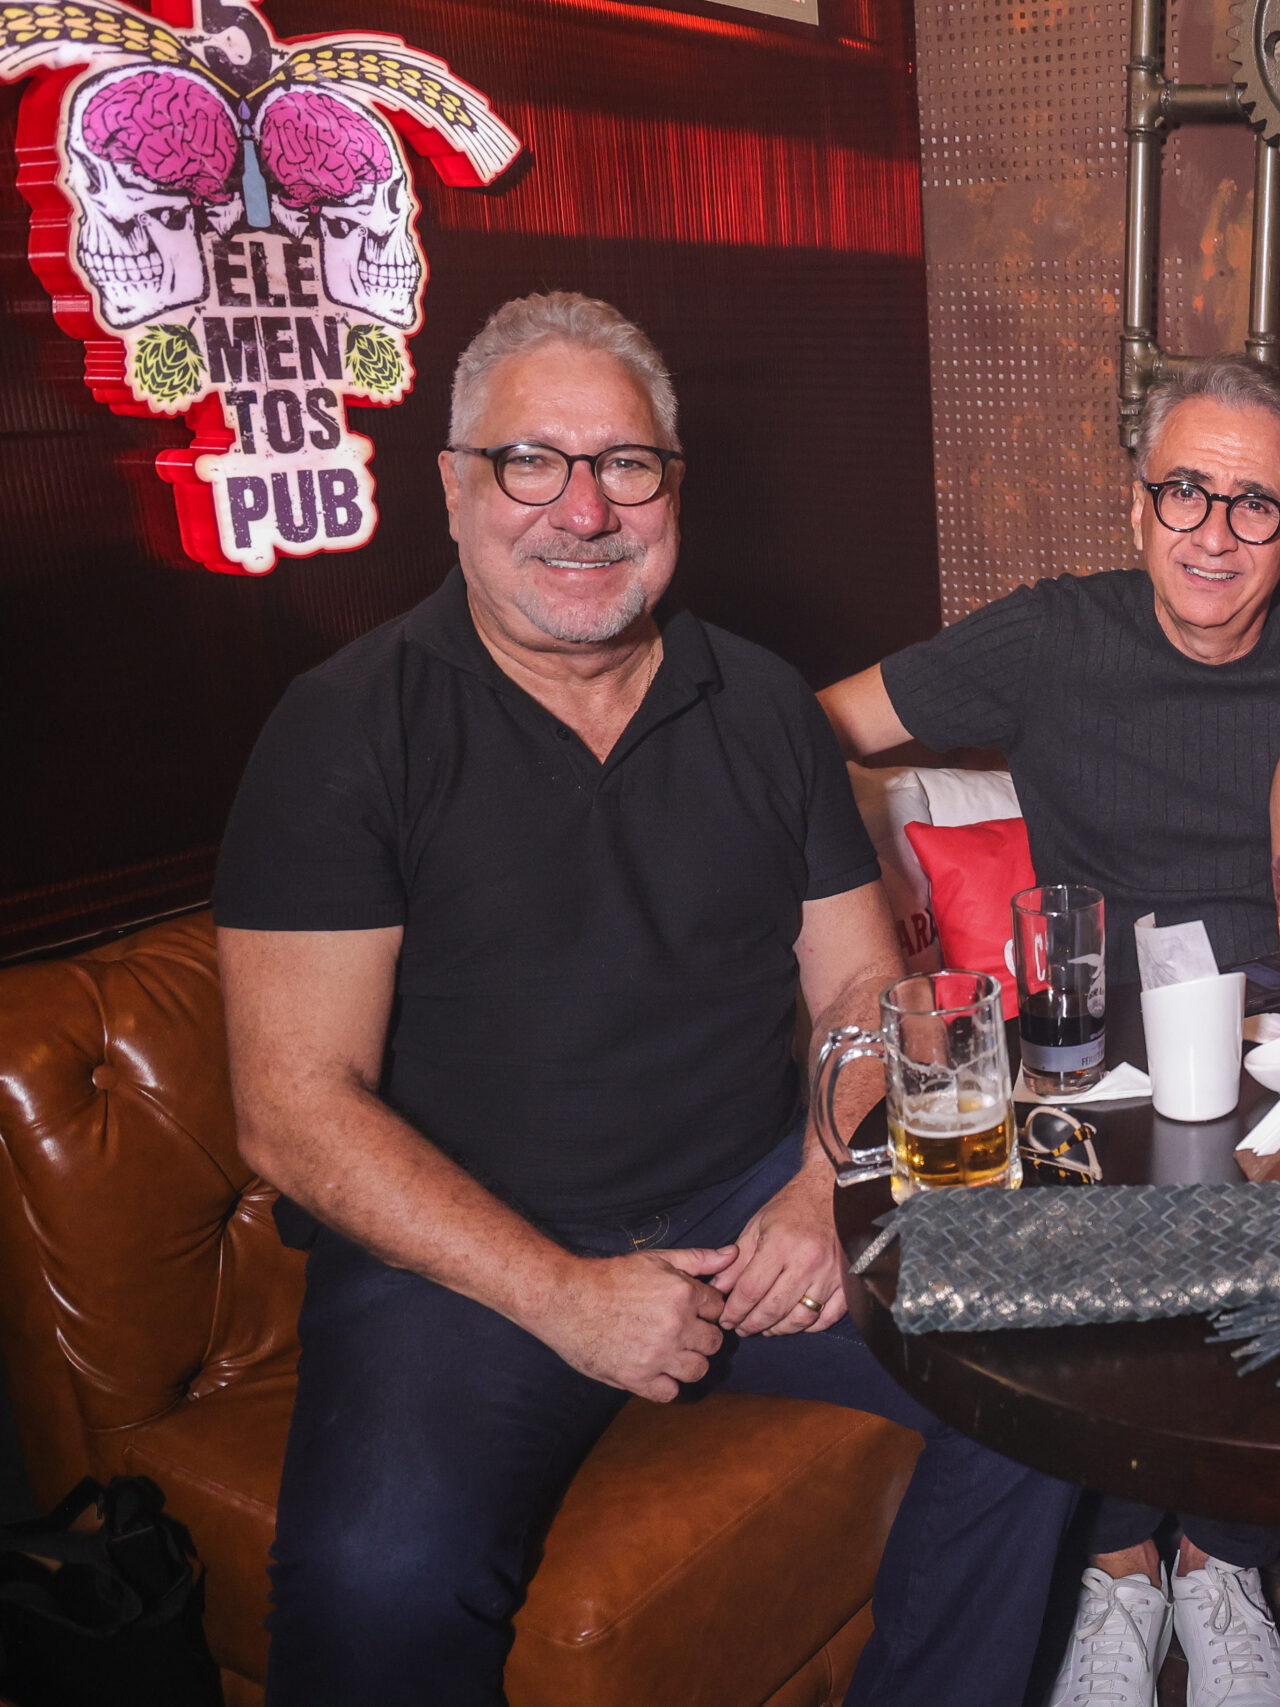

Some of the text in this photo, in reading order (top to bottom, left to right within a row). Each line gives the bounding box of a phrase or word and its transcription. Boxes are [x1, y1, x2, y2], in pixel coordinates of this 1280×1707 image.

[211, 240, 319, 307] ELE
[202, 315, 343, 383] MEN
[225, 387, 341, 454] TOS
[227, 468, 363, 549] PUB
